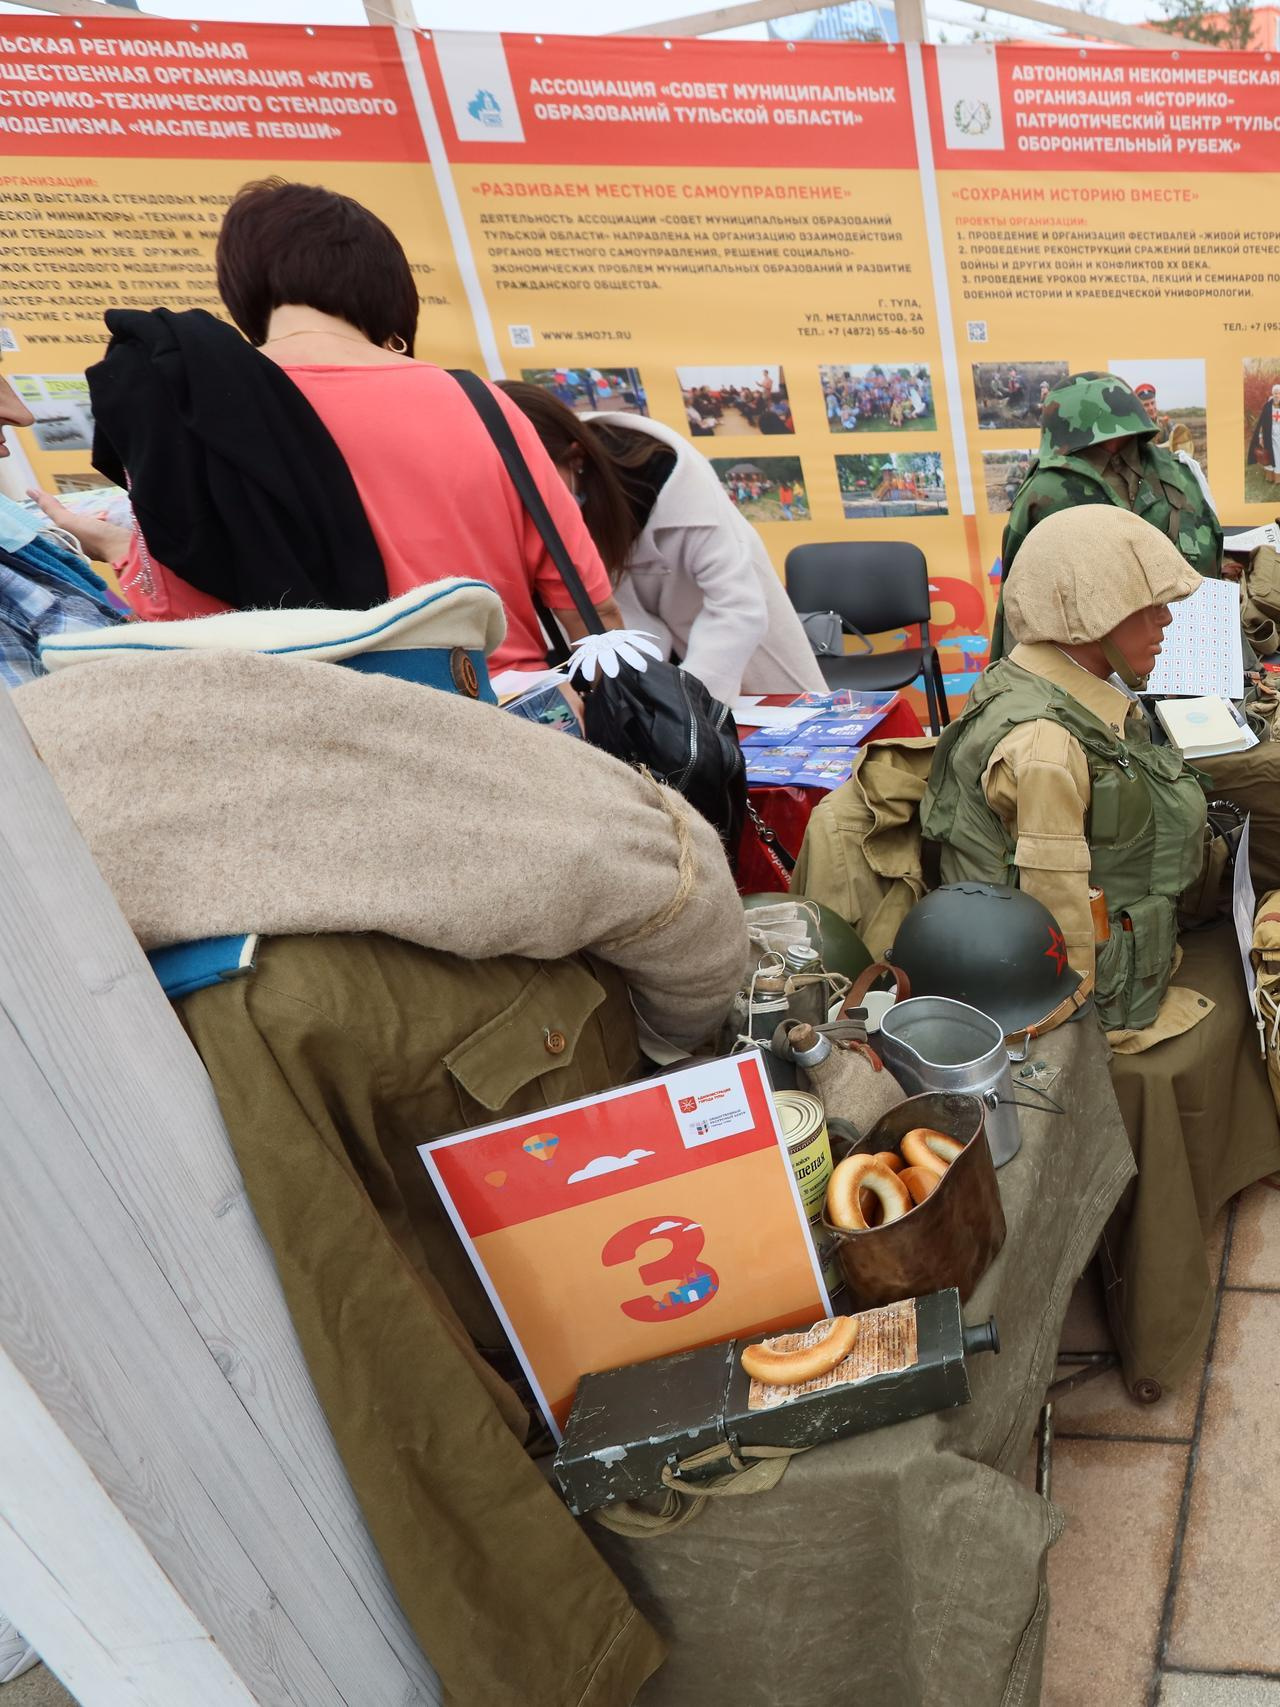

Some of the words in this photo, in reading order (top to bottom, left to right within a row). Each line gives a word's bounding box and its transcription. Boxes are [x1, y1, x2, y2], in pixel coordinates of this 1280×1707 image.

[0, 36, 75, 54] ЬСКАЯ
[78, 38, 248, 59] РЕГИОНАЛЬНАЯ
[0, 64, 151, 83] ЩЕСТВЕННАЯ
[154, 67, 304, 87] ОРГАНИЗАЦИЯ
[308, 71, 373, 88] «КЛУБ
[1012, 65, 1124, 82] АВТОНОМНАЯ
[1128, 68, 1280, 84] НЕКОММЕРЧЕСКАЯ
[529, 78, 656, 98] АССОЦИАЦИЯ
[660, 82, 728, 98] «СОВЕТ
[733, 83, 895, 102] МУНИЦИПАЛЬНЫХ
[0, 89, 263, 112] СТОРИКО-ТЕХНИЧЕСКОГО
[265, 96, 397, 115] СТЕНДОВОГО
[1013, 89, 1131, 106] ОРГАНИЗАЦИЯ
[1136, 91, 1233, 107] «ИСТОРИКО-
[534, 103, 670, 121] ОБРАЗОВАНИЙ
[673, 106, 768, 123] ТУЛЬСКОЙ
[773, 109, 862, 125] ОБЛАСТИ»
[1016, 112, 1164, 129] ПАТРИОТИЧЕСКИЙ
[1170, 115, 1221, 131] ЦЕНТР
[128, 119, 252, 138] «НАСЛЕДИЕ
[256, 122, 341, 138] ЛЕВШИ»
[1018, 136, 1172, 152] ОБОРОНИТЕЛЬНЫЙ
[1177, 138, 1240, 153] РУБЕЖ»
[595, 184, 676, 198] МЕСТНОЕ
[1050, 188, 1125, 201] ИСТОРИЮ
[479, 212, 574, 224] ДЕЯТЕЛЬНОСТЬ
[576, 213, 657, 225] АССОЦИАЦИИ
[704, 214, 809, 226] МУНИЦИПАЛЬНЫХ
[811, 215, 892, 226] ОБРАЗОВАНИЙ
[482, 229, 547, 241] ТУЛЬСКОЙ
[612, 230, 691, 241] НАПРАВЛЕНА
[692, 231, 710, 241] НА
[711, 231, 797, 242] ОРГАНИЗАЦИЮ
[798, 231, 903, 242] ВЗАИМОДЕЙСТВИЯ
[967, 230, 1039, 241] ПРОВЕДЕНИЕ
[1040, 231, 1050, 240] И
[1050, 230, 1126, 241] ОРГАНИЗАЦИЯ
[1127, 230, 1197, 241] ФЕСТИВАЛЕЙ
[487, 246, 543, 257] ОРГАНОВ
[544, 247, 607, 257] МЕСТНОГО
[723, 247, 780, 258] РЕШЕНИЕ
[781, 247, 854, 258] СОЦИАЛЬНО-
[969, 244, 1041, 255] ПРОВЕДЕНИЕ
[1043, 244, 1132, 255] РЕКОНСТРУКЦИЙ
[1133, 244, 1191, 255] СРАЖЕНИЙ
[1192, 244, 1240, 255] ВЕЛИКОЙ
[491, 263, 595, 274] ЭКОНОМИЧЕСКИХ
[597, 263, 654, 274] ПРОБЛЕМ
[655, 263, 760, 274] МУНИЦИПАЛЬНЫХ
[762, 263, 843, 274] ОБРАЗОВАНИЙ
[845, 263, 854, 273] И
[855, 263, 912, 273] РАЗВИТИЕ
[959, 260, 999, 270] ВОЙНЫ
[1001, 260, 1009, 270] И
[1011, 260, 1052, 270] ДРУГИХ
[1054, 259, 1083, 270] ВОЙН
[1085, 260, 1093, 269] И
[1094, 259, 1165, 270] КОНФЛИКТОВ
[1166, 260, 1179, 269] ХХ
[495, 279, 591, 291] ГРАЖДАНСКОГО
[973, 274, 1044, 285] ПРОВЕДЕНИЕ
[1045, 273, 1087, 284] УРОКОВ
[1151, 272, 1193, 284] ЛЕКЦИЙ
[1194, 273, 1202, 283] И
[1203, 273, 1265, 283] СЕМИНАРОВ
[1266, 272, 1280, 283] ПО
[962, 289, 1013, 300] ВОЕННОЙ
[1014, 289, 1063, 299] ИСТОРИИ
[1064, 289, 1073, 298] И
[1074, 288, 1162, 299] КРАЕВЕДЧЕСКОЙ
[909, 312, 924, 322] 2А
[827, 326, 840, 336] +7
[841, 326, 875, 337] (4872)
[876, 325, 925, 336] 55-46-50
[1249, 321, 1261, 331] +7
[540, 329, 632, 341] WWW.SMO71.RU
